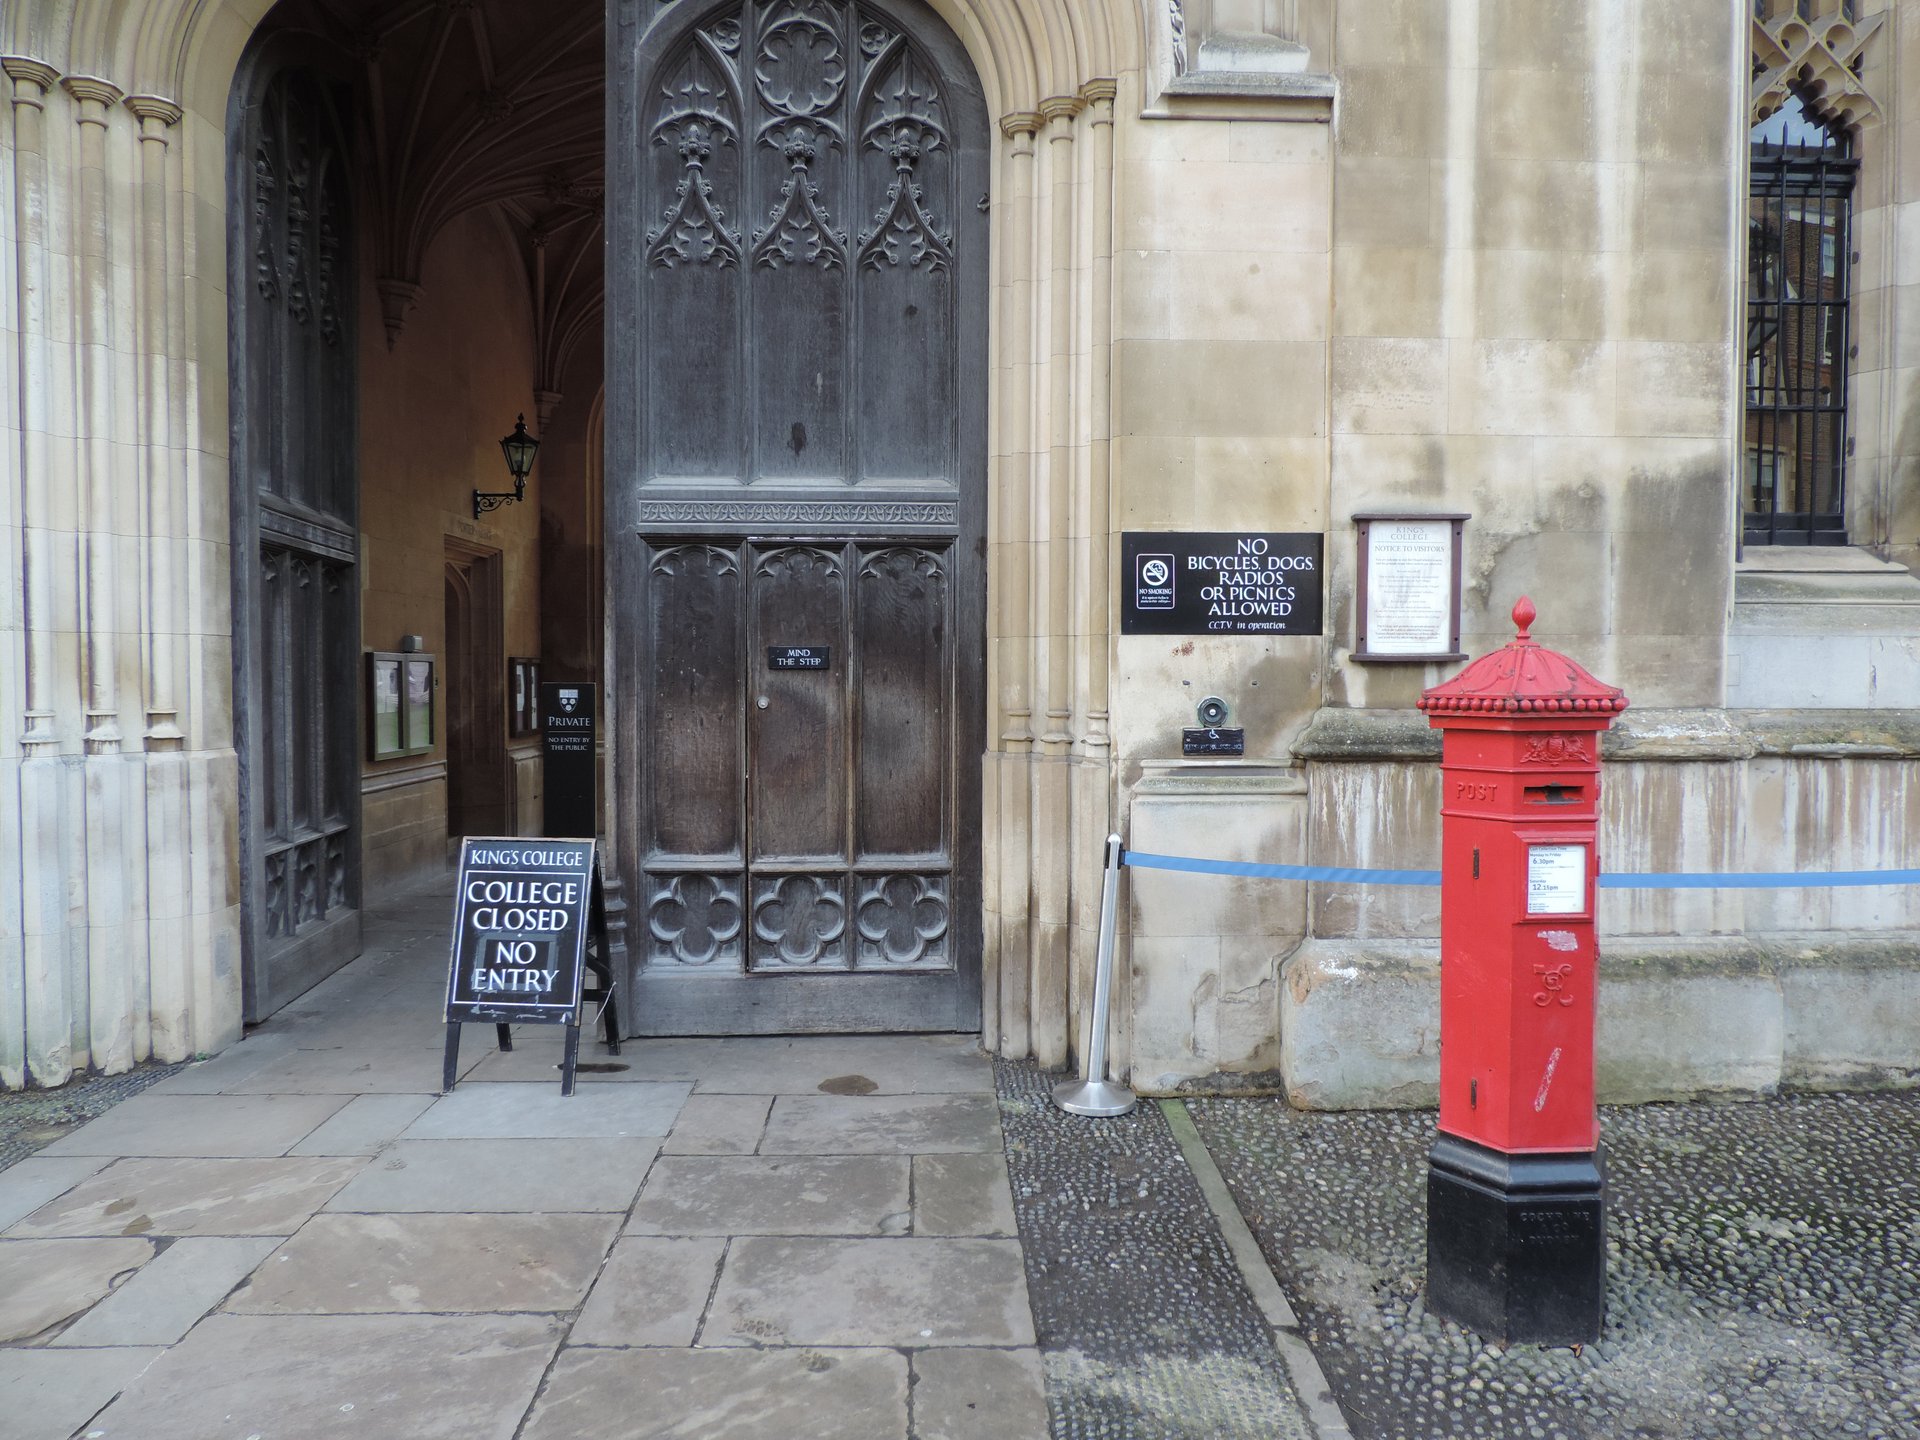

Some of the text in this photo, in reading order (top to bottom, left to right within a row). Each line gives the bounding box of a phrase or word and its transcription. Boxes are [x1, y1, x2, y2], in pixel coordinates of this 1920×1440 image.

[1237, 538, 1268, 555] NO
[1374, 545, 1445, 553] NOTICE TO VISITORS
[1219, 571, 1284, 586] RADIOS
[1200, 586, 1296, 601] OR PICNICS
[1208, 602, 1293, 616] ALLOWED
[1237, 621, 1246, 629] in
[1248, 621, 1287, 631] operation
[788, 649, 810, 657] MIND
[776, 658, 822, 666] THE STEP
[549, 716, 590, 726] PRIVATE
[1456, 782, 1498, 802] POST
[470, 849, 583, 866] KING'S COLLEGE
[467, 881, 578, 905] COLLEGE
[473, 908, 569, 931] CLOSED
[495, 941, 537, 965] NO
[472, 968, 560, 992] ENTRY
